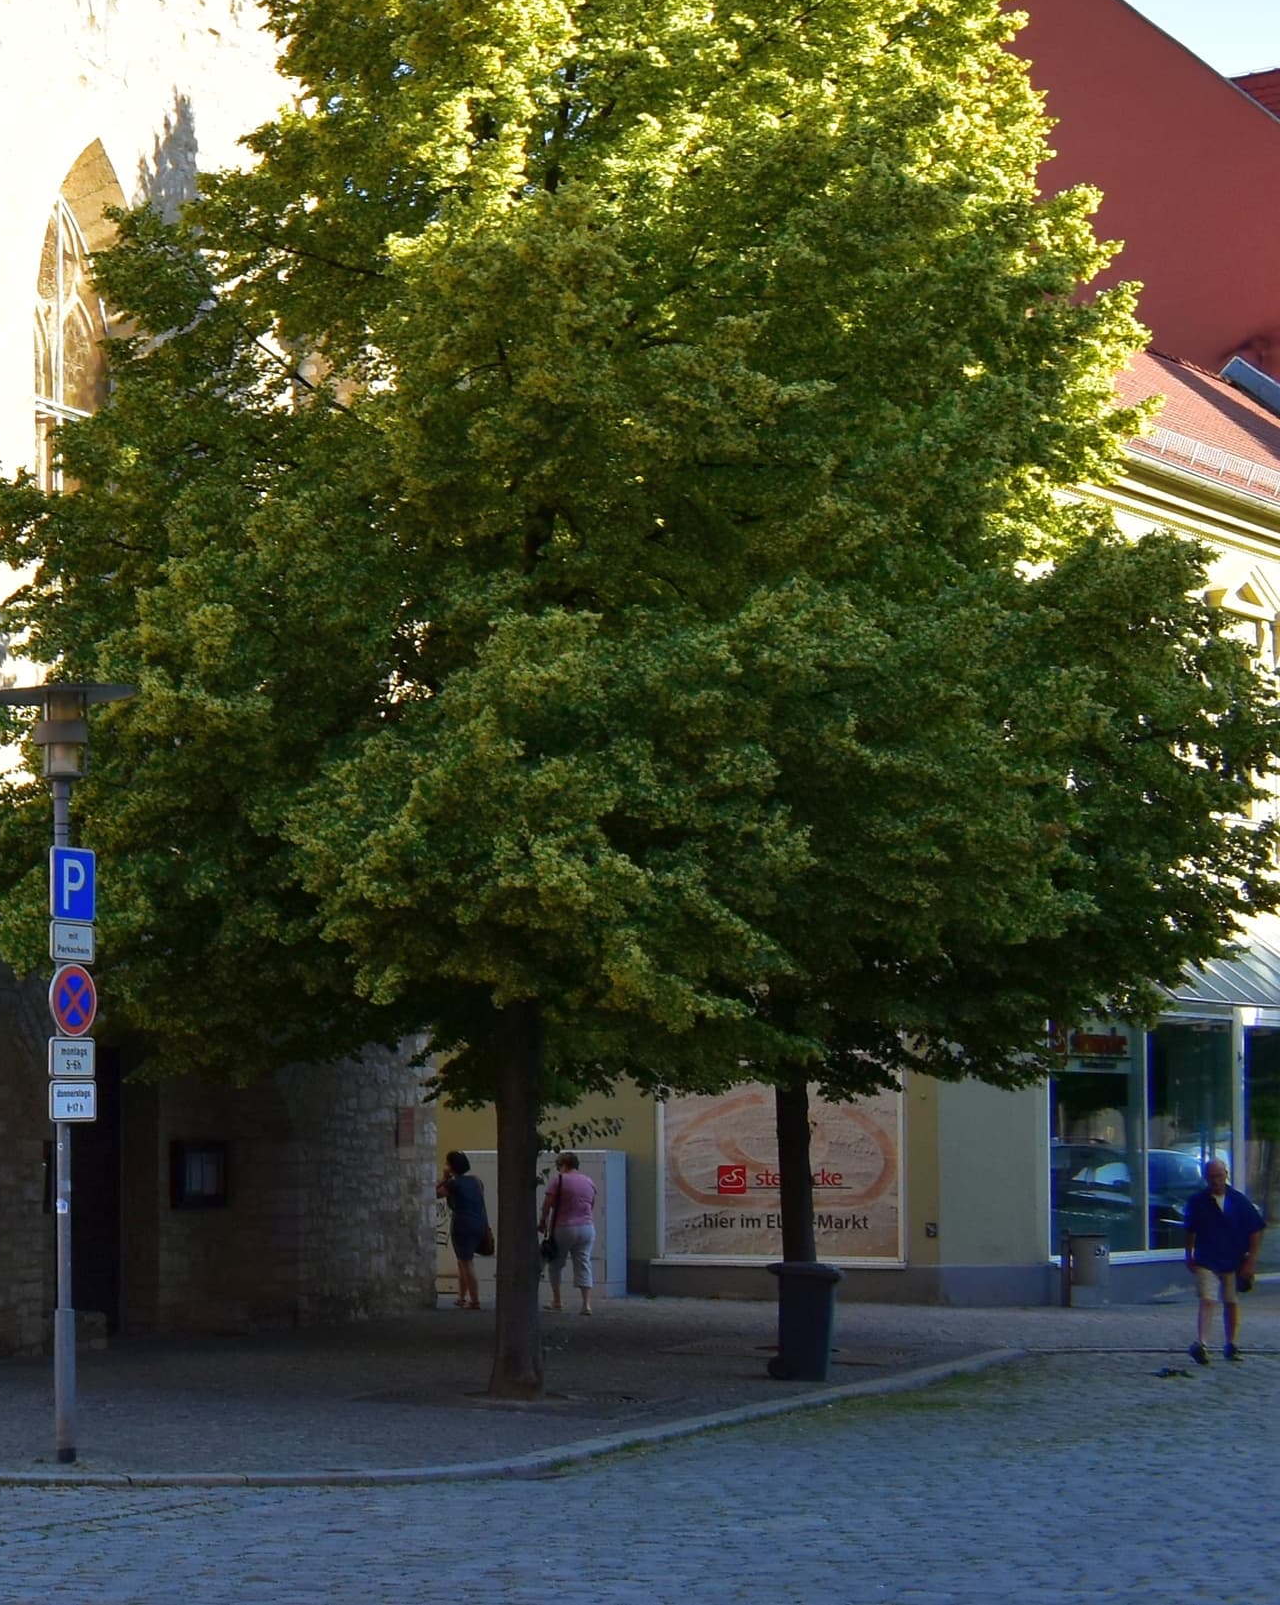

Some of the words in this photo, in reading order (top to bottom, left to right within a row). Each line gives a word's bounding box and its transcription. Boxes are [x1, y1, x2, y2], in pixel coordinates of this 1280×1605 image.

[63, 858, 85, 910] P
[755, 1168, 843, 1186] stecke
[740, 1215, 761, 1229] im
